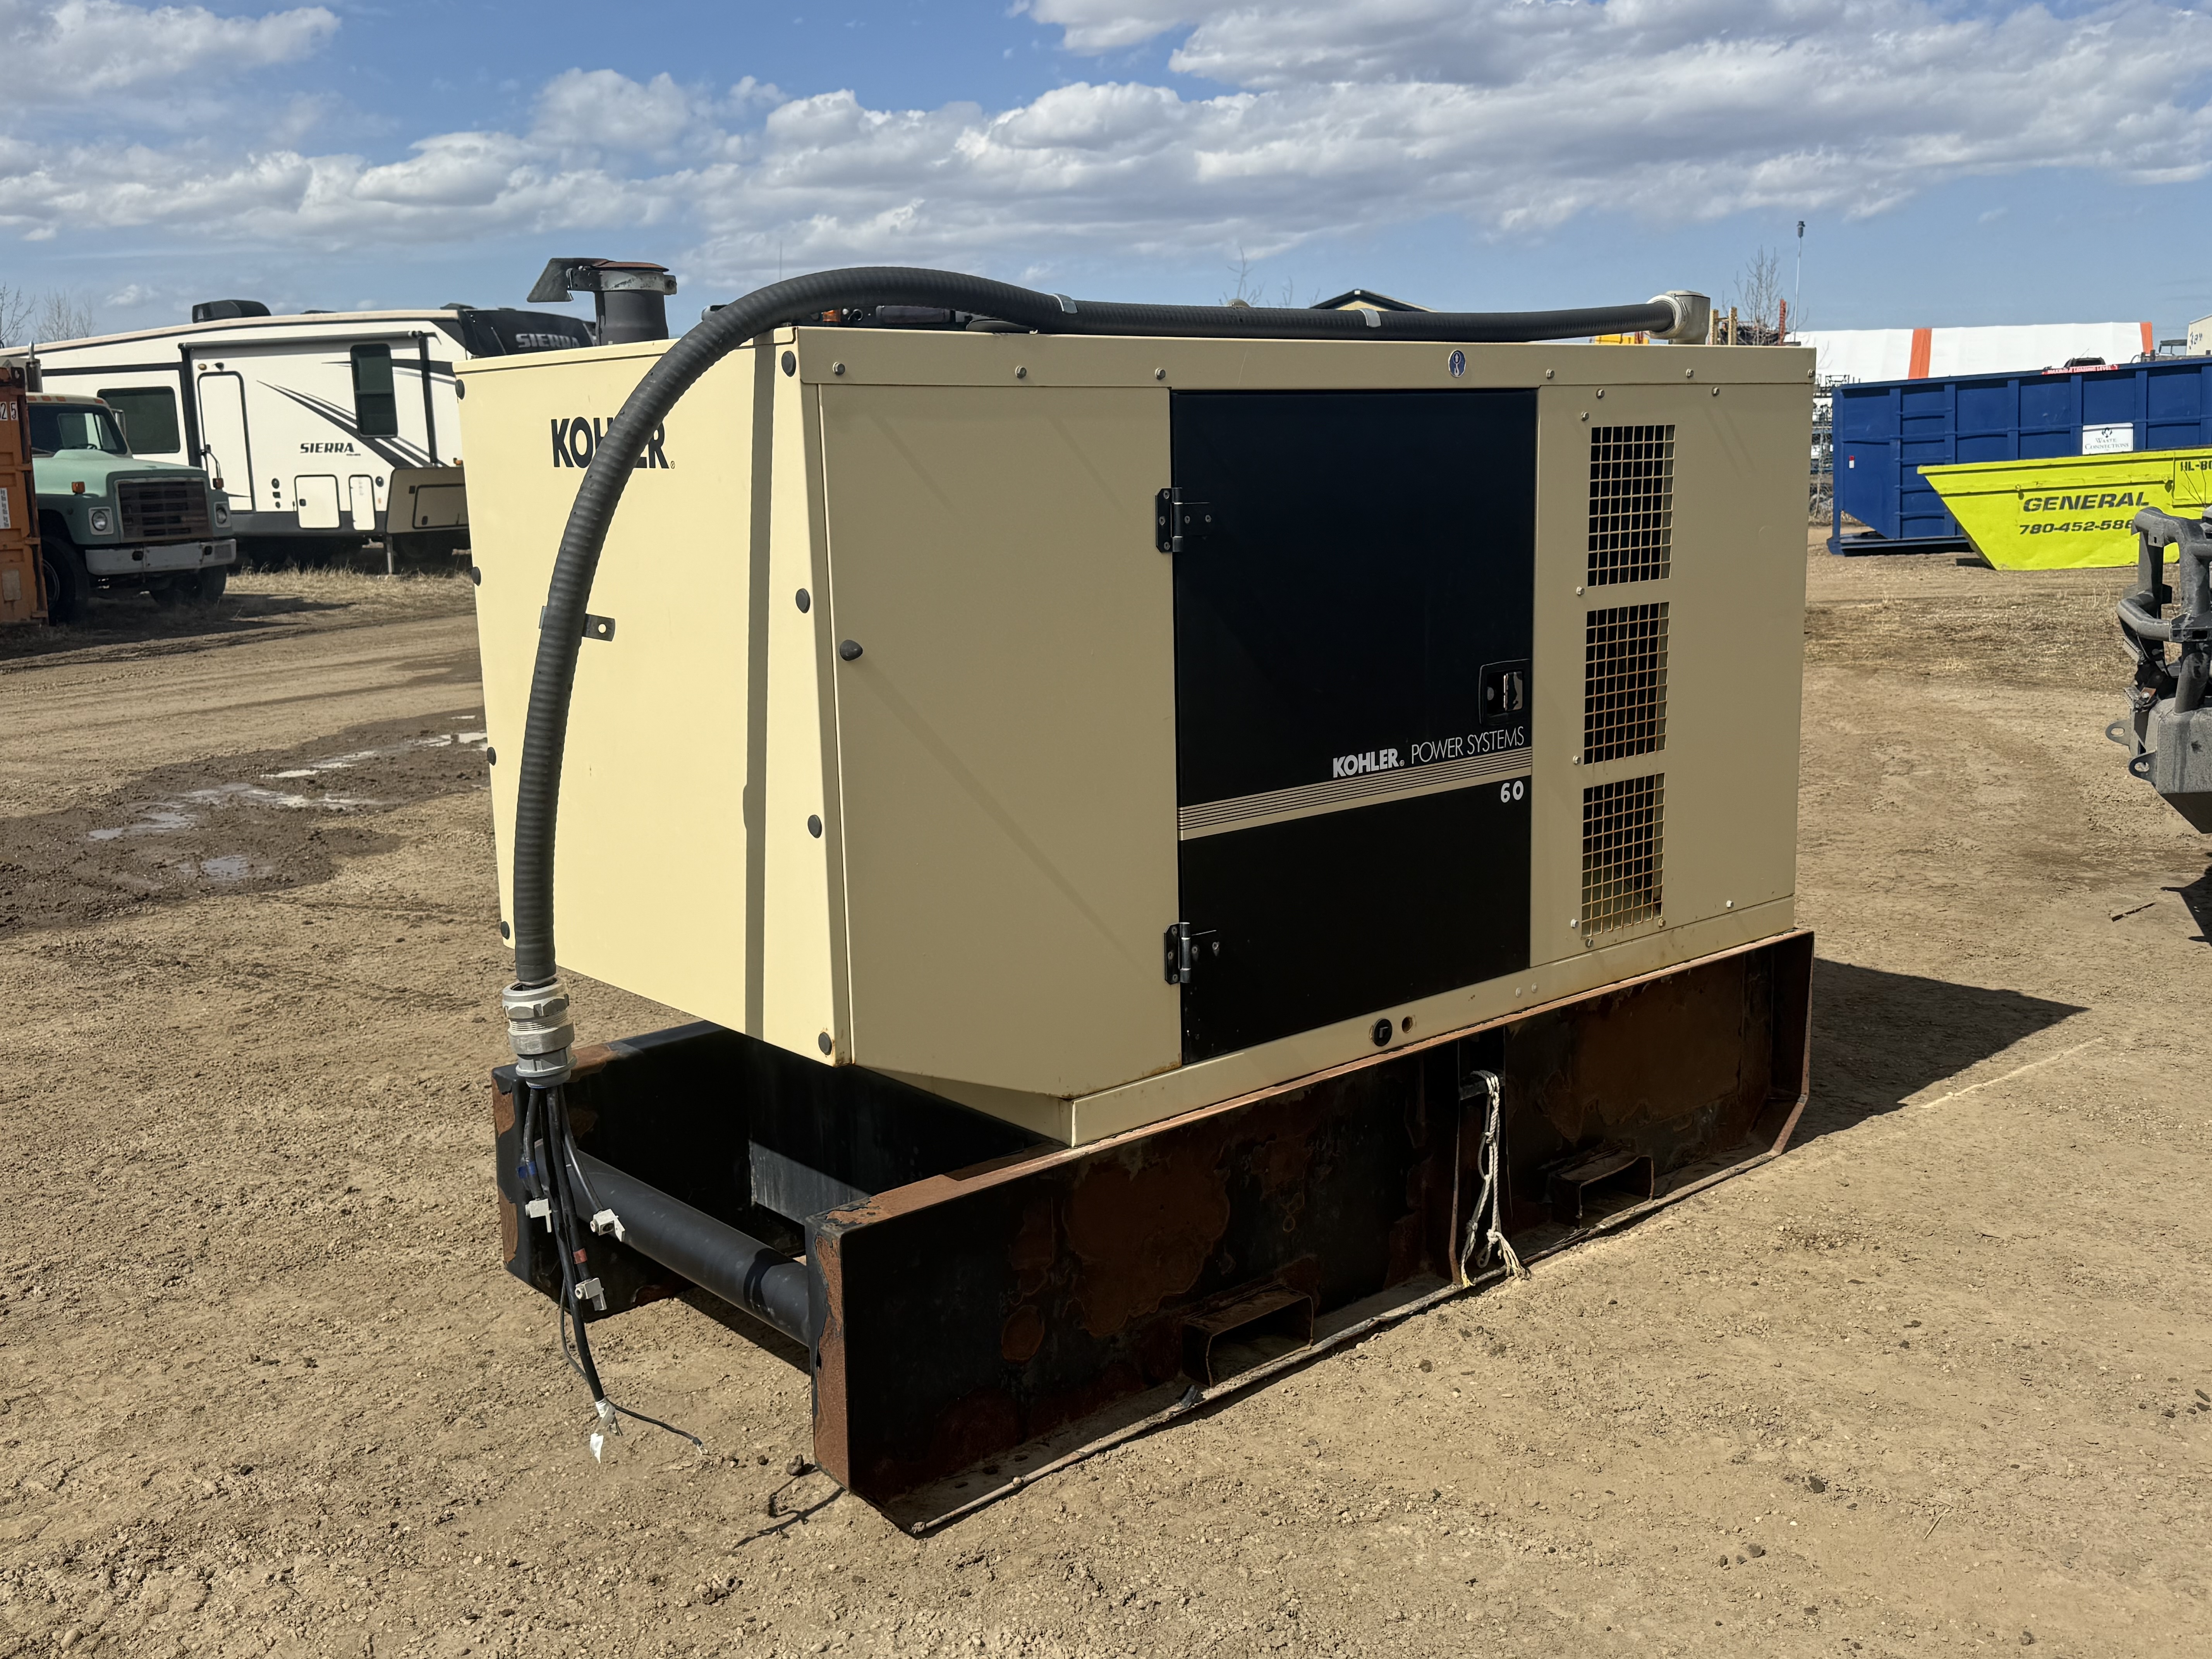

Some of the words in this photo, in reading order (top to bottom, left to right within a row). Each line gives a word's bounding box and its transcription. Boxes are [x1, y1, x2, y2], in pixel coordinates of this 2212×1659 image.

[516, 333, 580, 348] SIERRA
[0, 403, 16, 419] 25
[300, 443, 354, 453] SIERRA
[551, 417, 670, 469] KOR
[2023, 492, 2149, 512] GENERAL
[2020, 519, 2134, 534] 780-452-586
[1333, 748, 1400, 778] KOHLER
[1412, 737, 1463, 764] POWER
[1467, 726, 1524, 755] SYSTEMS
[1501, 780, 1524, 803] 60
